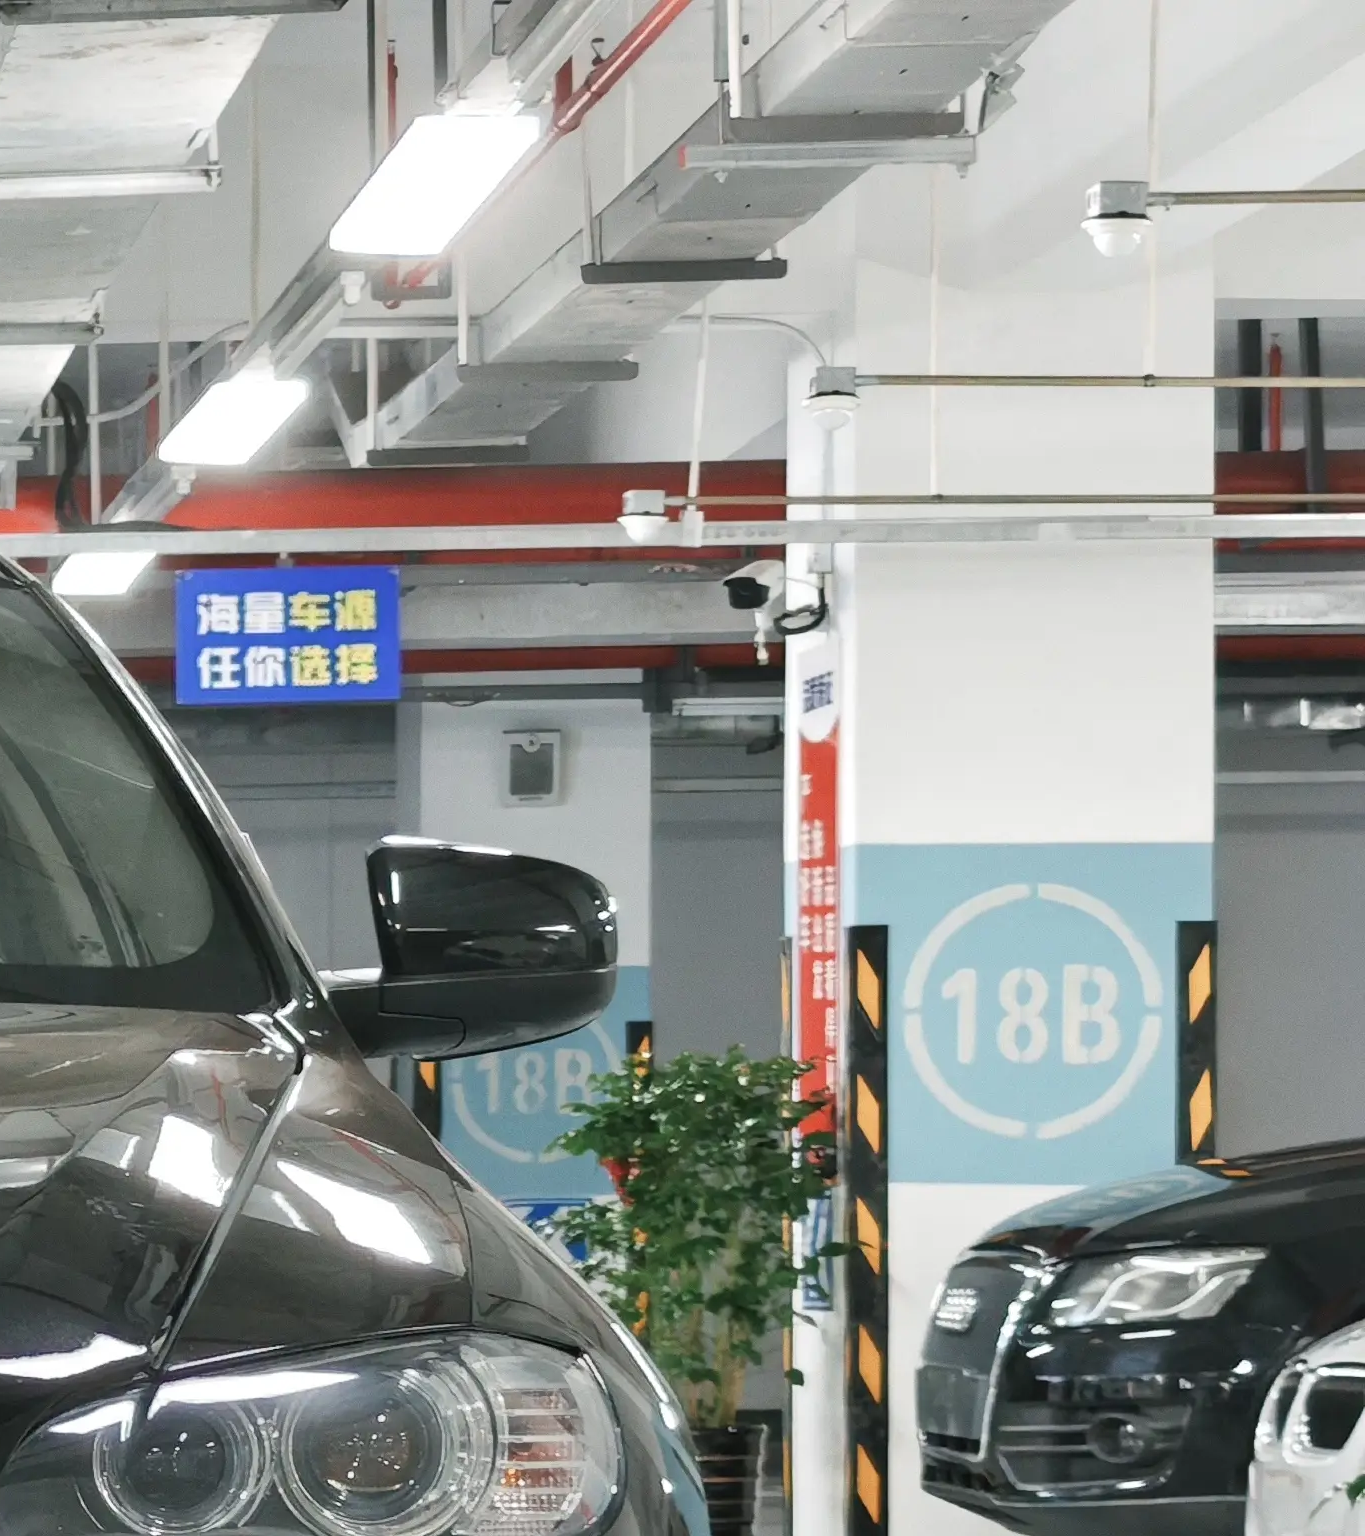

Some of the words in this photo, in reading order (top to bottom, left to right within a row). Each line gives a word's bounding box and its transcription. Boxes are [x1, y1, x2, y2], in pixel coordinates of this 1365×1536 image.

[196, 588, 377, 636] 海量车源
[197, 643, 378, 689] 任你选择
[941, 964, 1122, 1065] 18B
[476, 1048, 593, 1115] 18B
